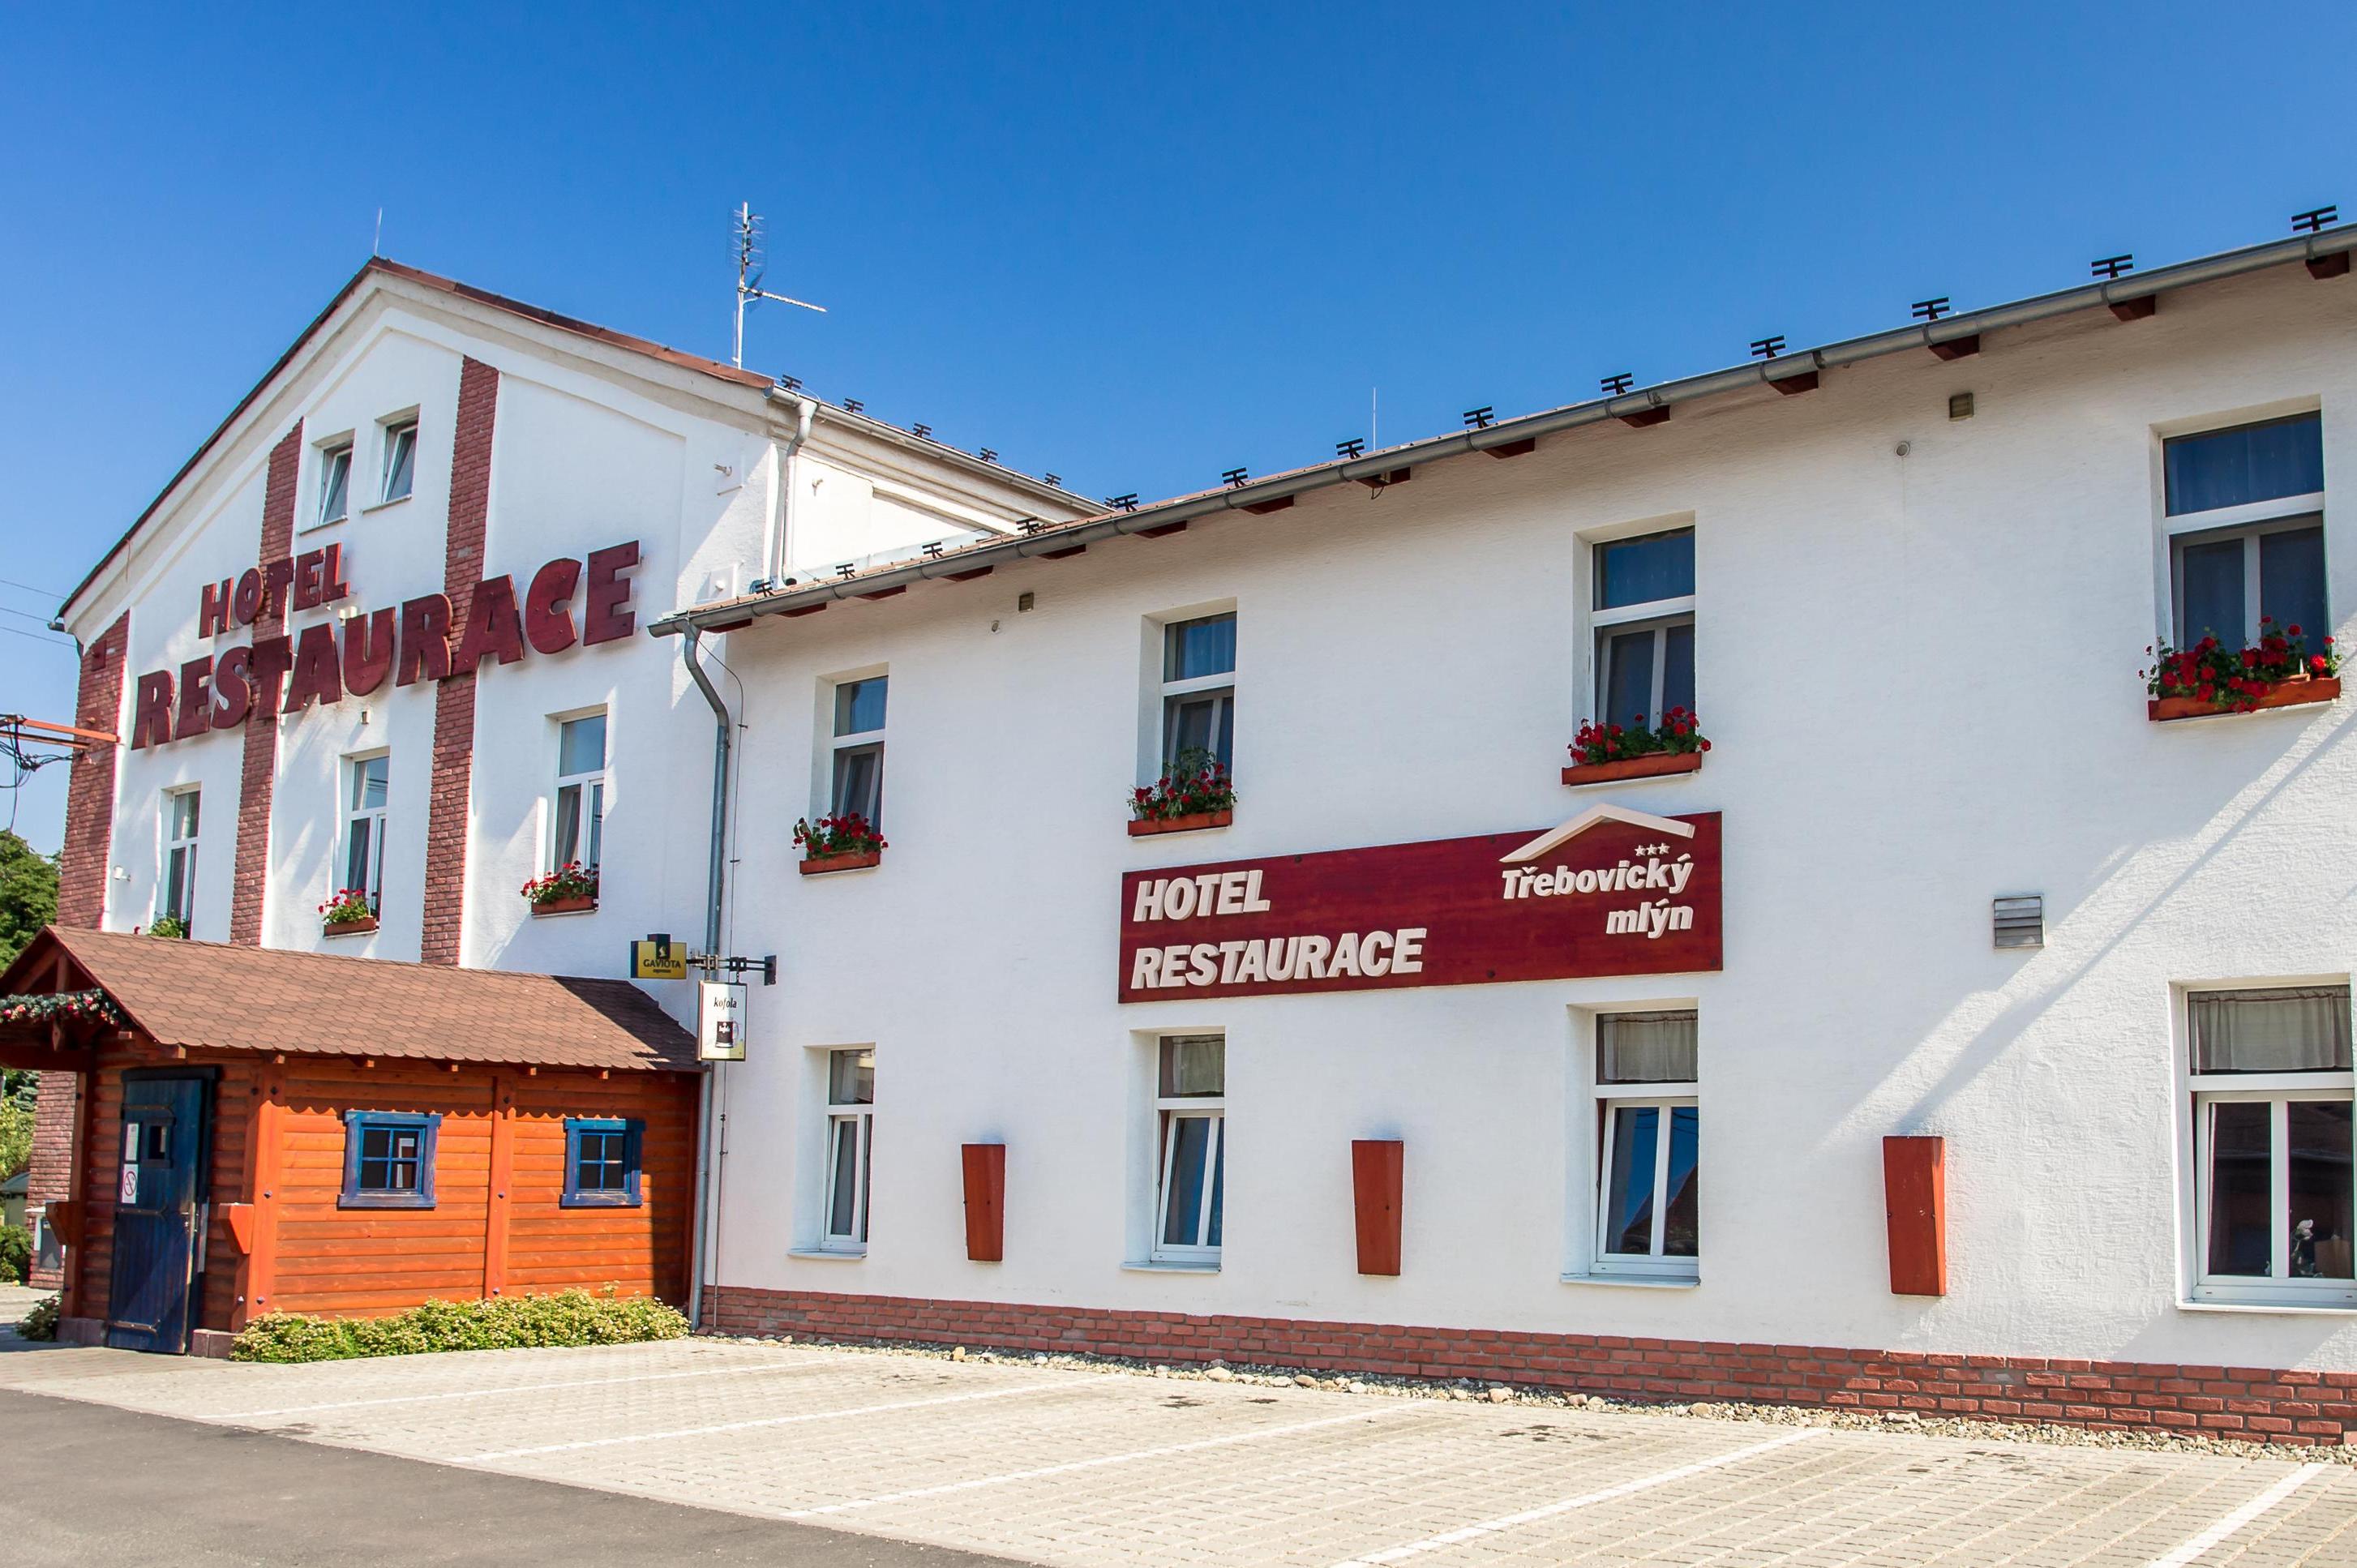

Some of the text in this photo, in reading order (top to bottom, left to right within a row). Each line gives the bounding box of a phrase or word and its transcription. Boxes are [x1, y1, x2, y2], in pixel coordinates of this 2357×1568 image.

[199, 542, 350, 639] HOTEL
[131, 540, 641, 751] RESTAURACE
[1133, 869, 1271, 922] HOTEL
[1502, 853, 1695, 900] Třebovický
[1605, 898, 1694, 939] mlýn
[643, 958, 682, 969] GAVIOTA
[1130, 928, 1428, 989] RESTAURACE
[714, 996, 737, 1010] kofola
